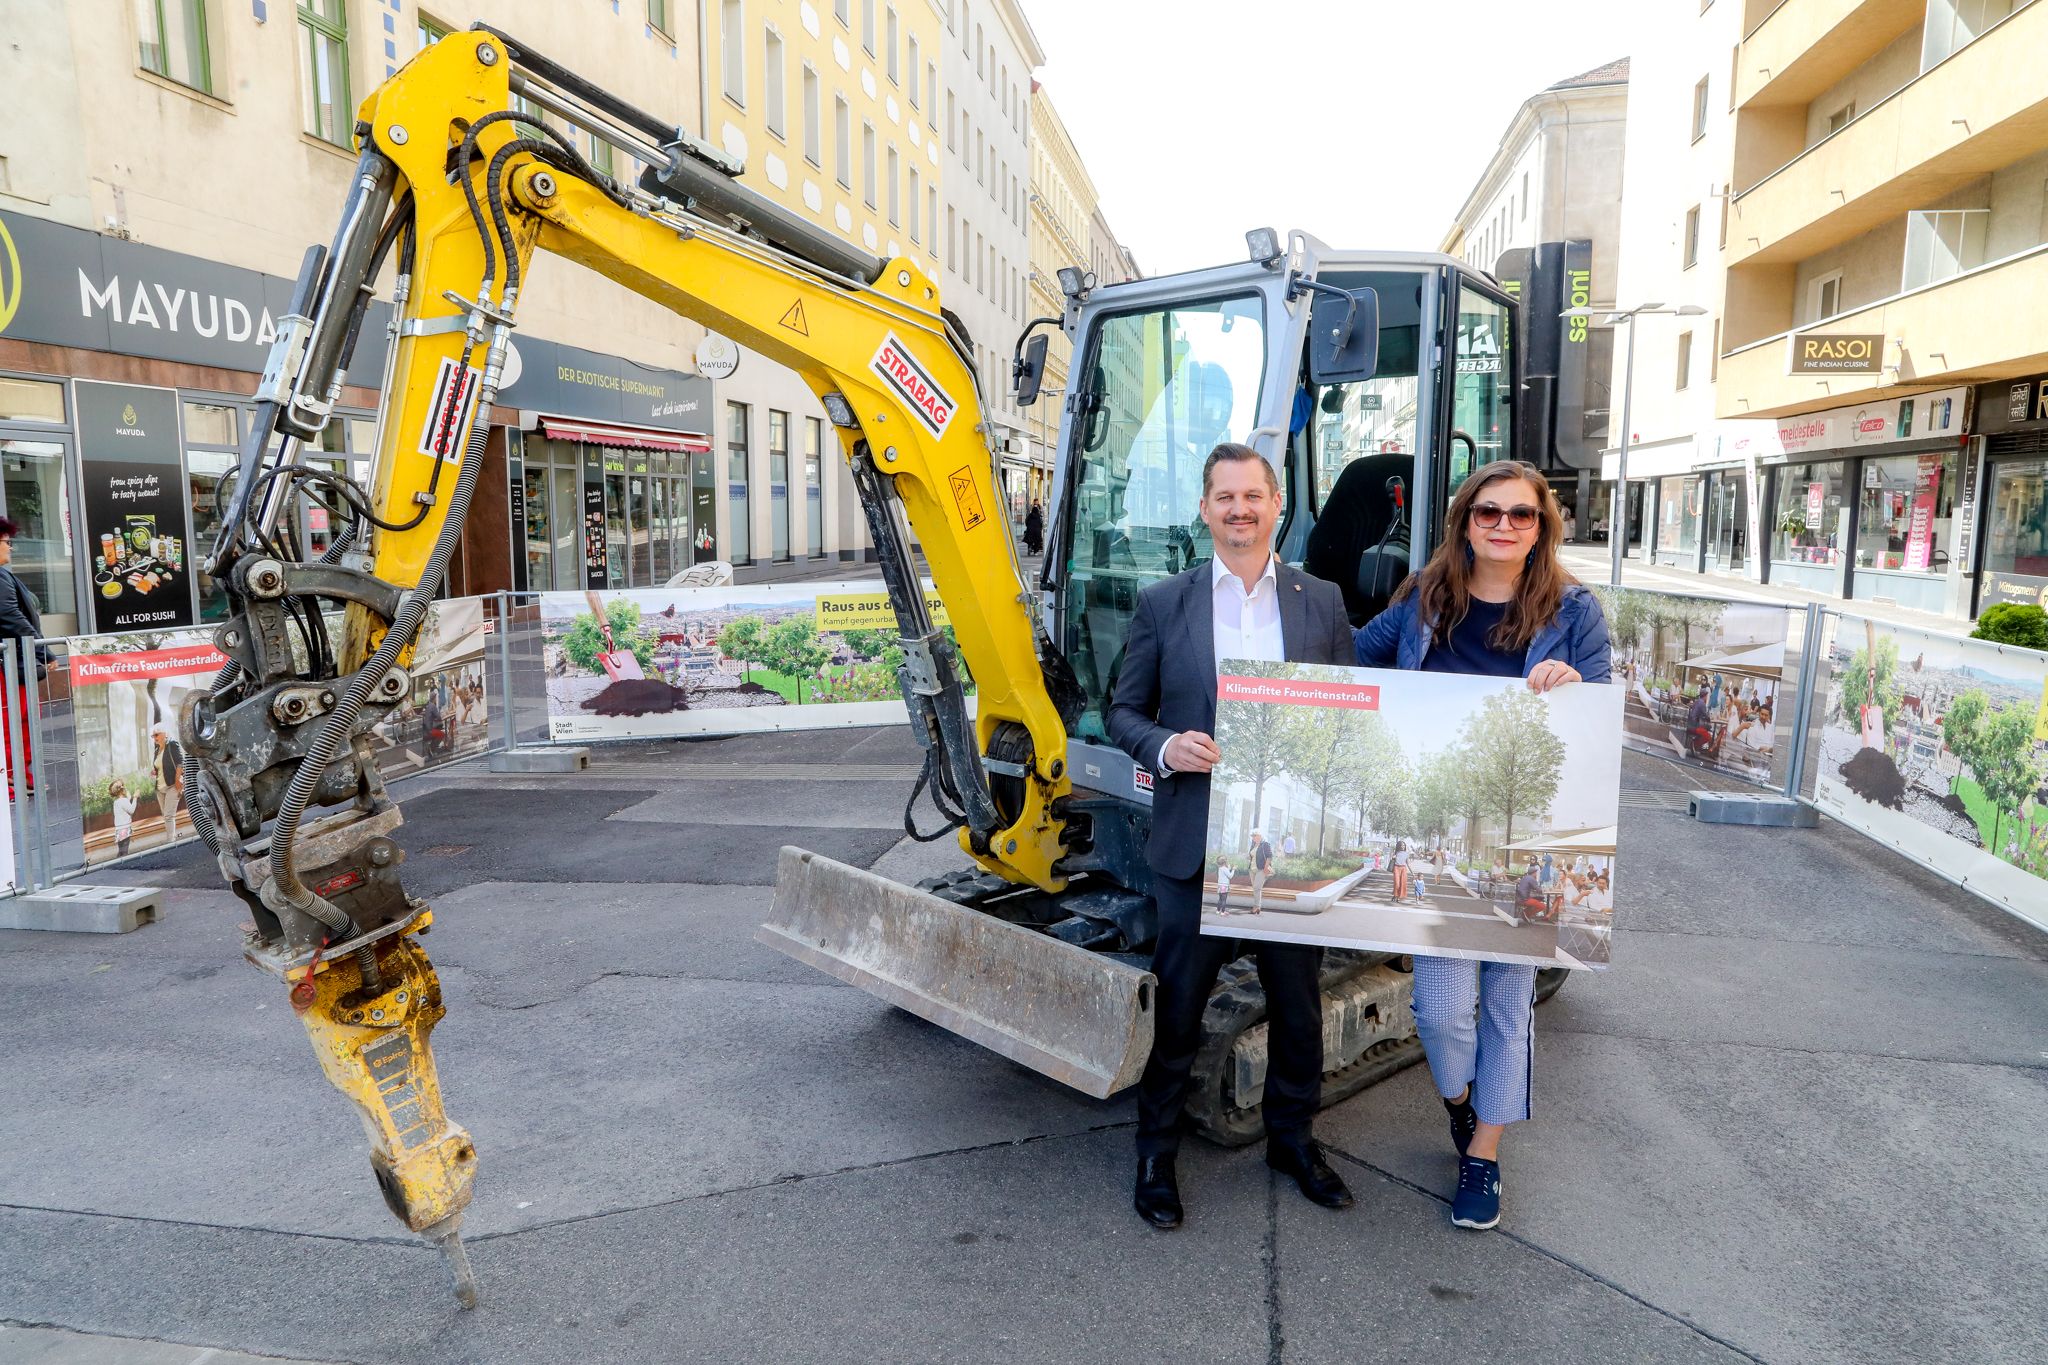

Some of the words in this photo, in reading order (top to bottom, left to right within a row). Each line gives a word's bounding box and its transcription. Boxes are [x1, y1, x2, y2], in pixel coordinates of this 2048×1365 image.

[78, 267, 278, 347] MAYUDA
[1805, 340, 1872, 358] RASOI
[700, 361, 733, 369] MAYUDA
[558, 366, 575, 382] DER
[576, 370, 620, 390] EXOTISCHE
[621, 379, 665, 398] SUPERMARKT
[879, 347, 947, 424] STRABAG
[115, 428, 146, 437] MAYUDA
[1778, 421, 1825, 441] meldestelle
[110, 477, 126, 488] from
[145, 474, 159, 487] dips
[112, 491, 119, 499] to
[822, 601, 855, 612] Raus
[857, 601, 881, 611] aus
[115, 614, 132, 625] ALL
[132, 613, 151, 623] FOR
[152, 610, 176, 621] SUSHI
[823, 616, 849, 627] Kampf
[851, 616, 877, 625] gegen
[139, 651, 224, 671] Favoritenstraße
[1226, 683, 1281, 697] Klimafitte
[1284, 687, 1372, 703] Favoritenstraße
